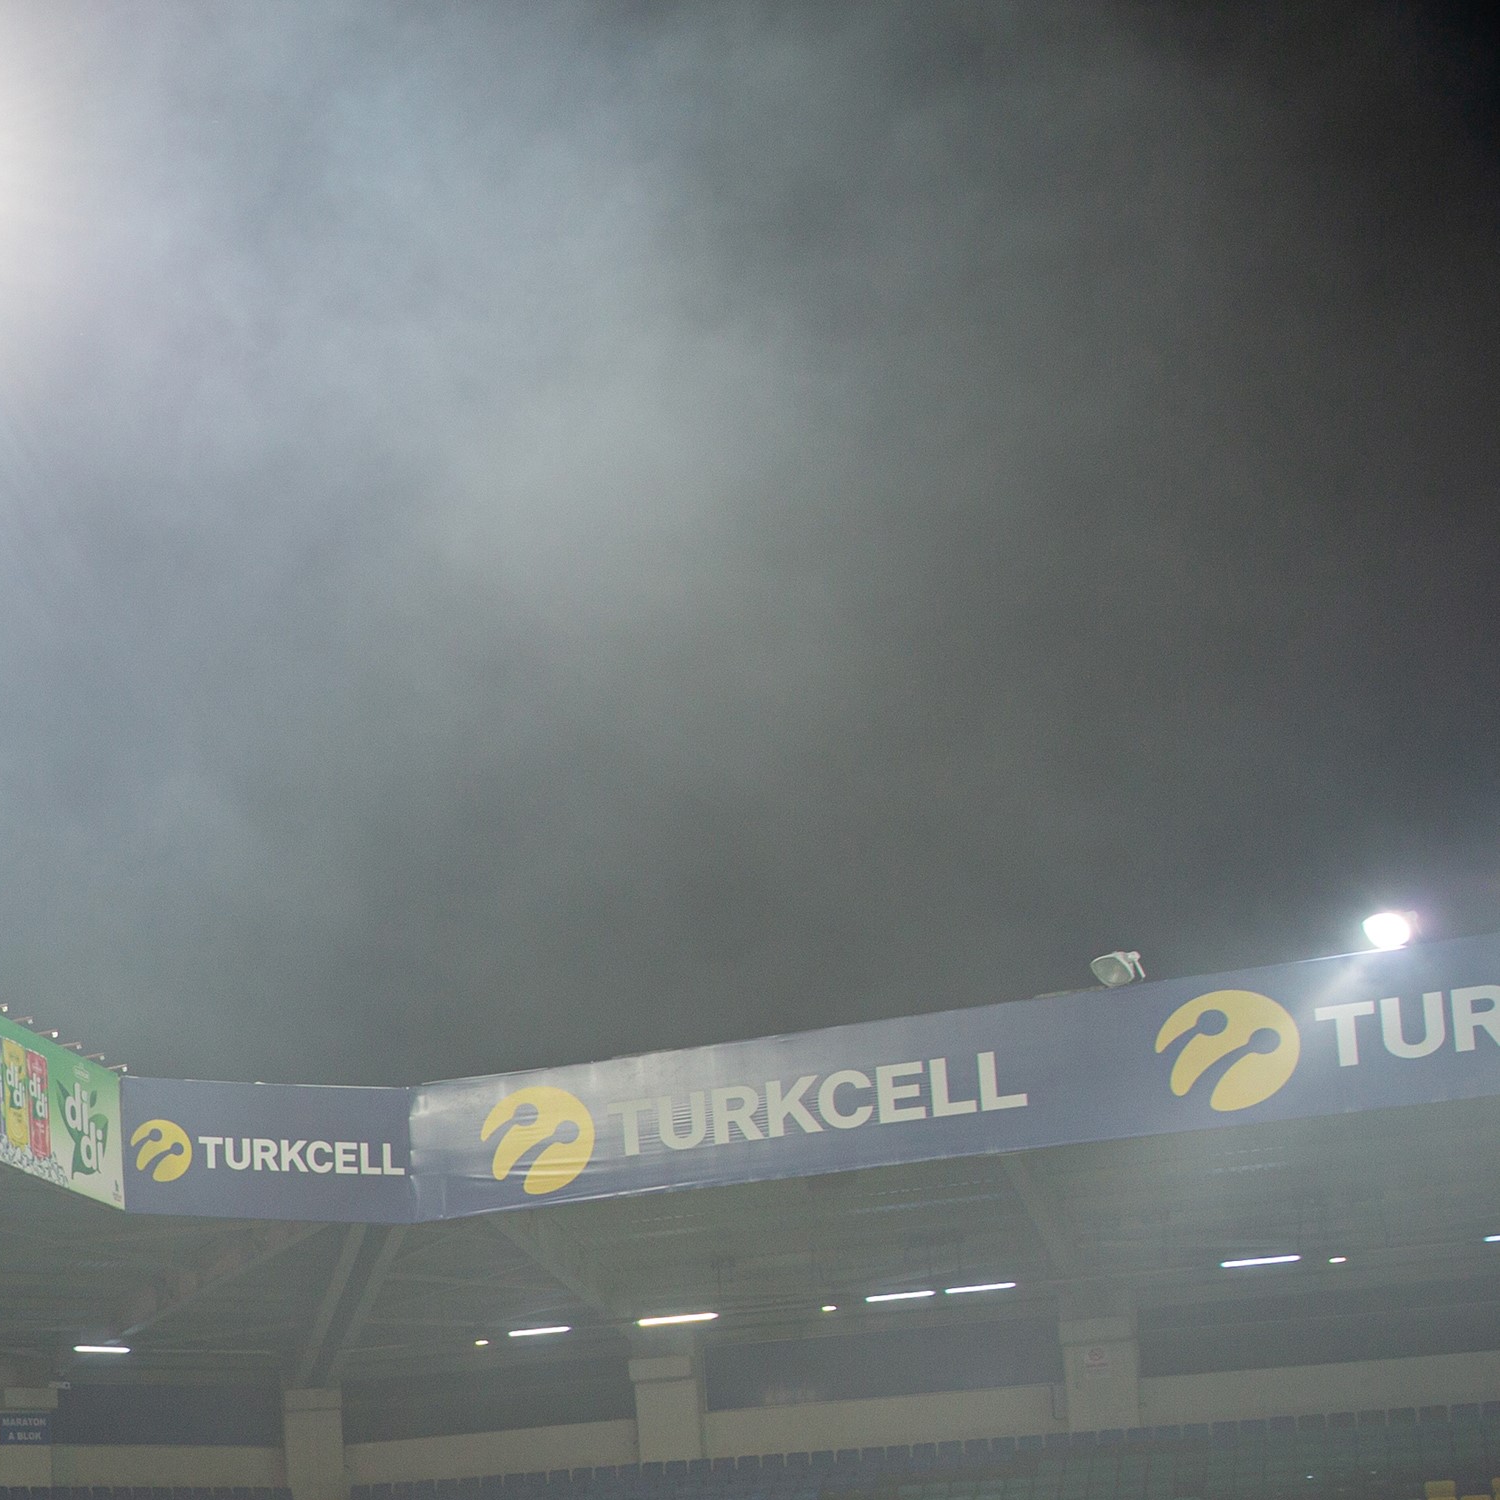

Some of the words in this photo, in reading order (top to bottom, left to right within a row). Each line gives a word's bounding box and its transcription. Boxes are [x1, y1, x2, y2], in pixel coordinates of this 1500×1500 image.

[6, 1062, 19, 1089] di
[29, 1073, 41, 1100] di
[13, 1082, 25, 1108] di
[36, 1093, 47, 1118] di
[65, 1082, 88, 1134] di
[607, 1050, 1029, 1157] TURKCELL
[81, 1121, 102, 1171] di
[198, 1135, 405, 1177] TURKCELL
